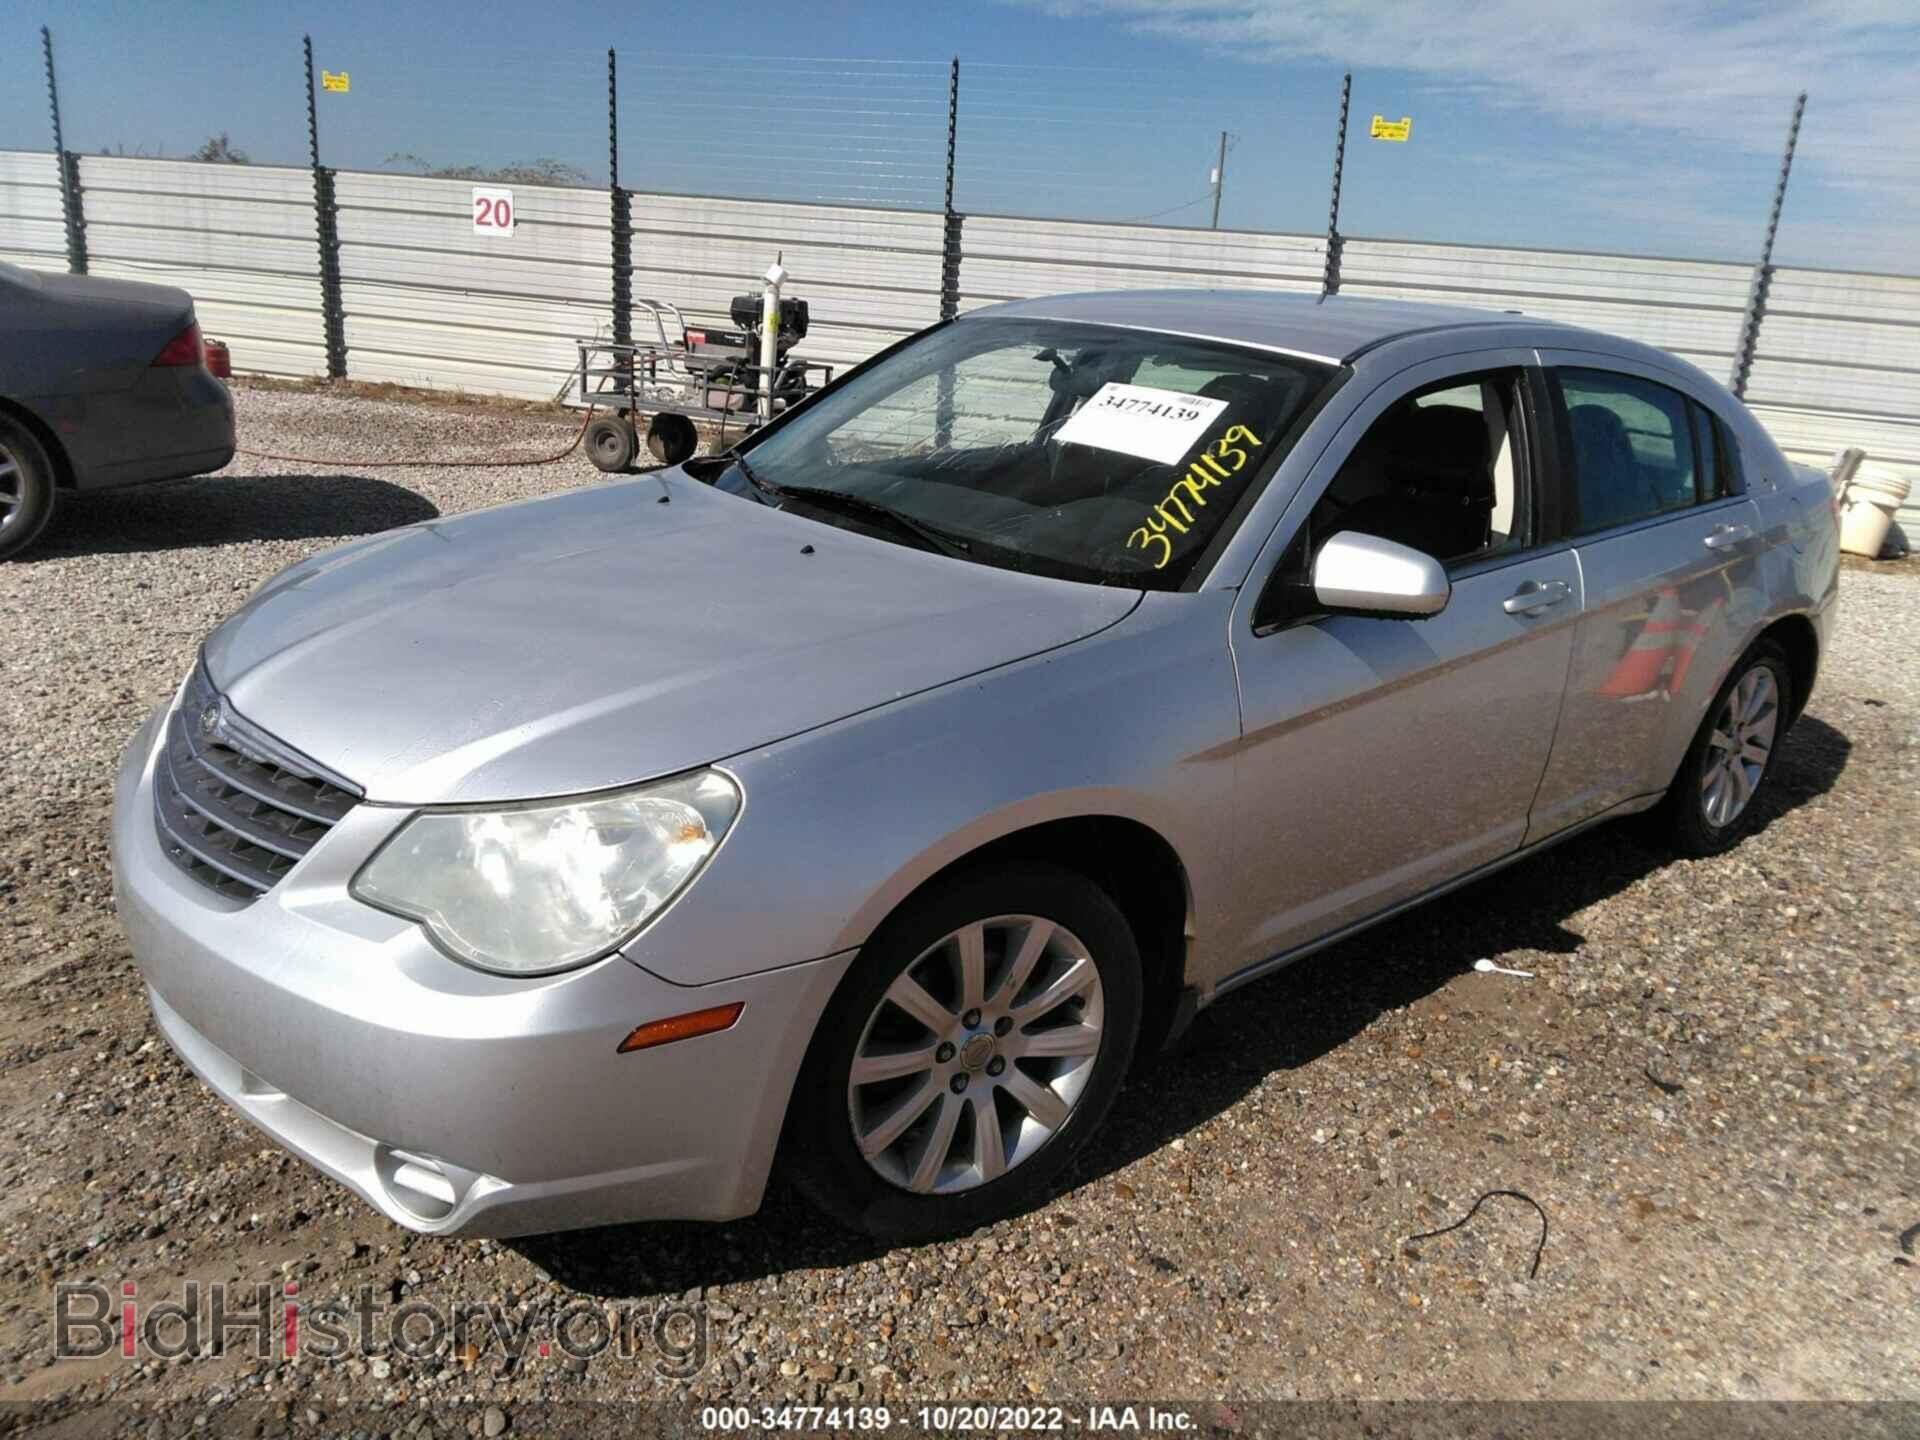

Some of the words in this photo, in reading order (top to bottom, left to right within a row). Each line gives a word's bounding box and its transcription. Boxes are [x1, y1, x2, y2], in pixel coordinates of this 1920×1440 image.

[476, 198, 510, 227] 20
[1099, 396, 1200, 421] 34774139
[1126, 424, 1263, 570] 34774139
